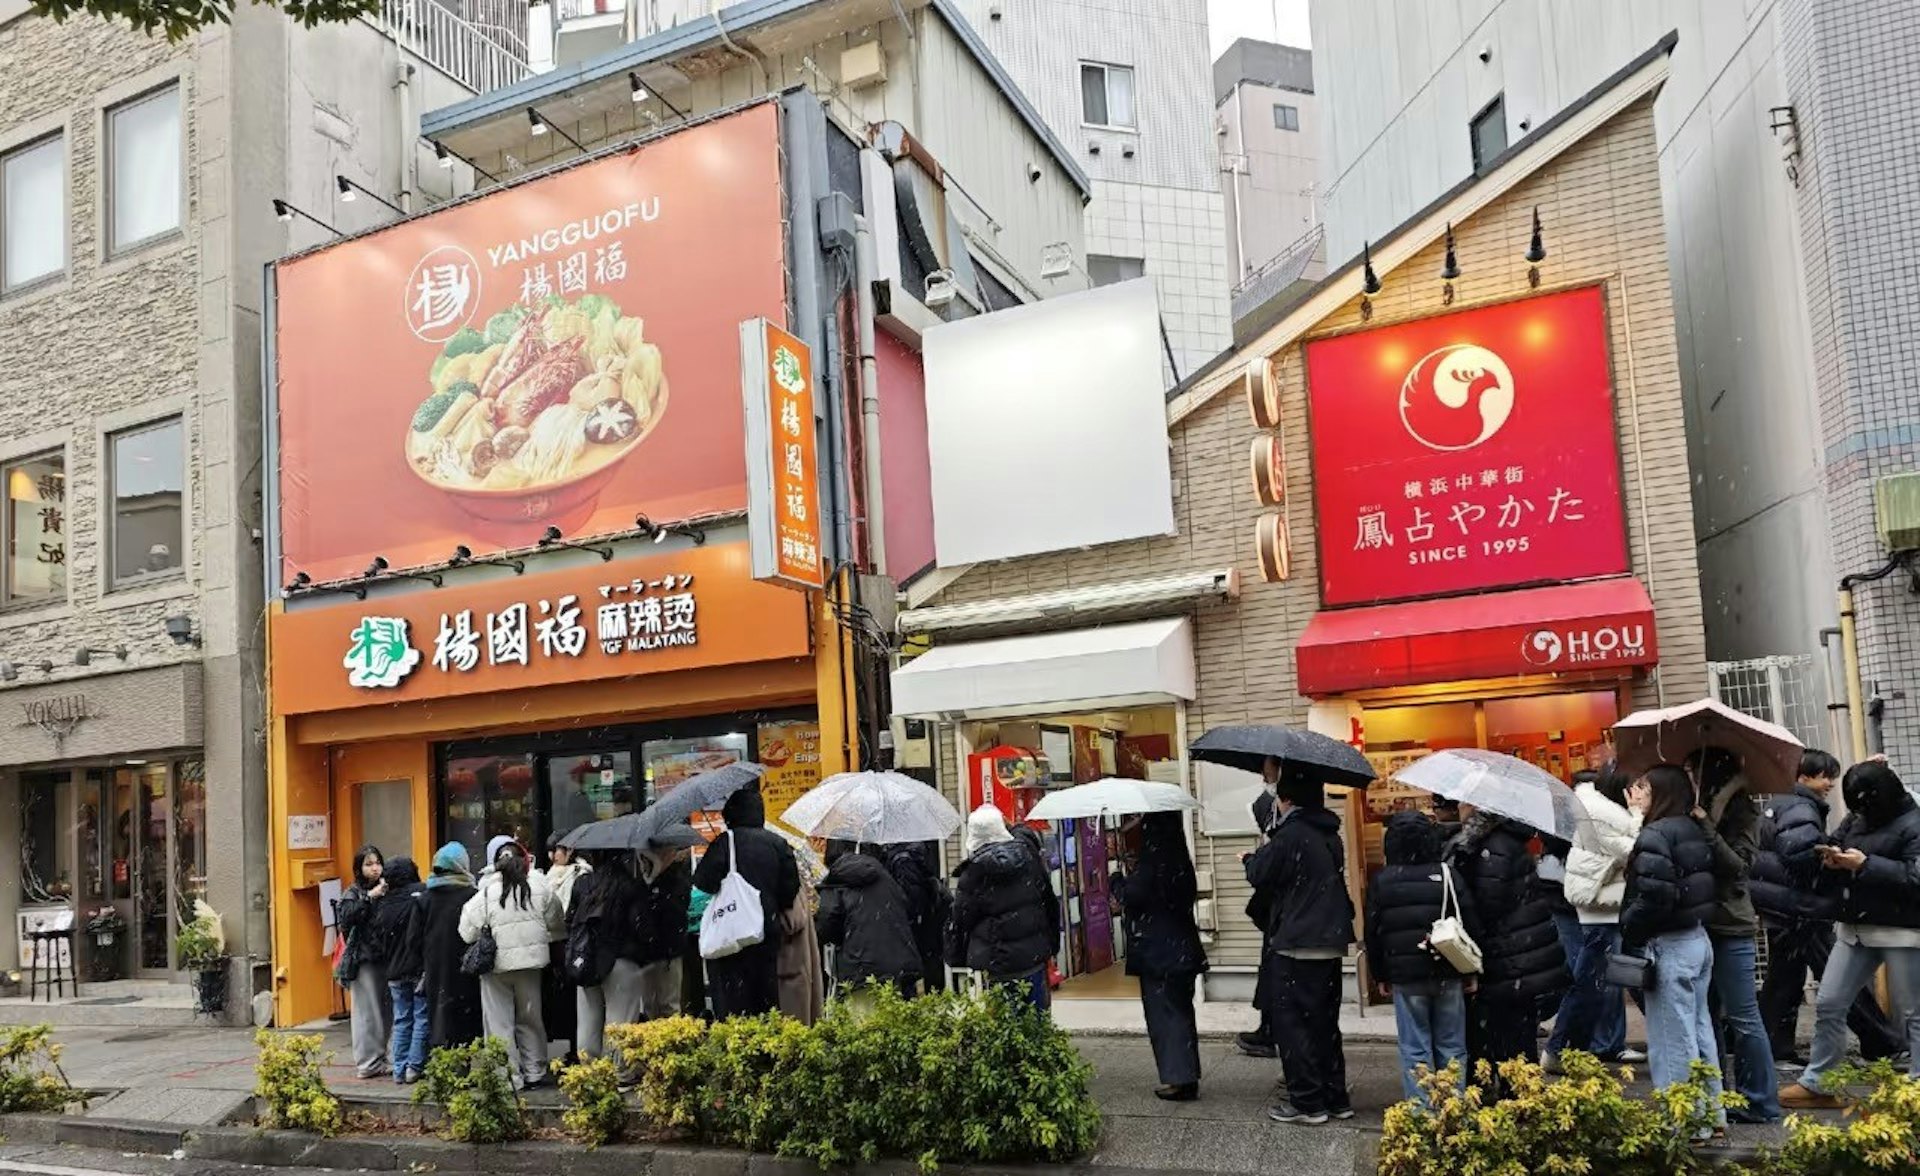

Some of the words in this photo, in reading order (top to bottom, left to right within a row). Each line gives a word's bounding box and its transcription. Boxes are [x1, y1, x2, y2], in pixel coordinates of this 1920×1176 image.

[487, 197, 661, 268] YANGGUOFU
[520, 241, 628, 305] 楊國福
[781, 398, 806, 522] 楊國福
[1405, 465, 1524, 499] 横浜中華街
[1408, 545, 1468, 565] SINCE
[1482, 536, 1530, 556] 1995
[598, 574, 693, 599] マーラータン
[432, 594, 588, 673] 楊國福
[600, 639, 622, 654] YGF
[627, 630, 697, 651] MALATANG
[1567, 624, 1644, 653] HOU
[1569, 651, 1607, 663] SINCE
[1616, 646, 1645, 658] 1995
[796, 731, 820, 740] How
